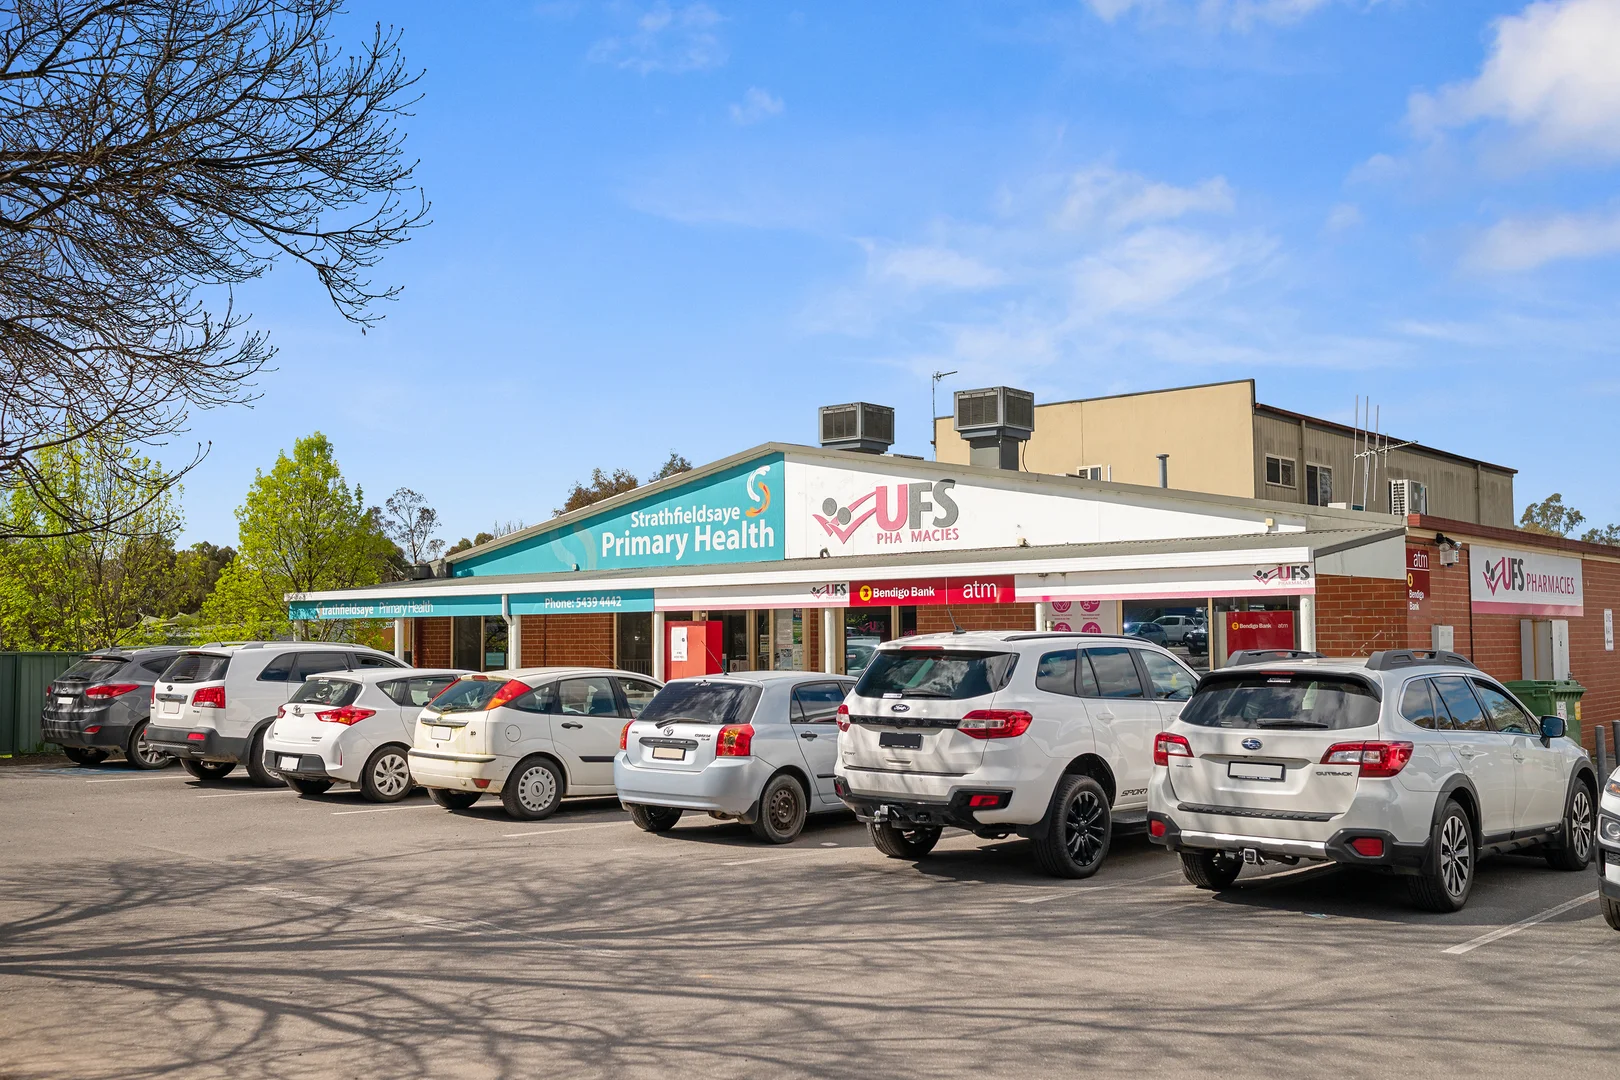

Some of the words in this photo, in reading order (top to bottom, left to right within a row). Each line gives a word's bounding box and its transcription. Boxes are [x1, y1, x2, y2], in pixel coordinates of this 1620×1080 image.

[876, 478, 959, 531] UFS
[631, 504, 740, 528] Strathfieldsaye
[602, 530, 689, 560] Primary
[694, 519, 775, 552] Health
[1413, 551, 1428, 568] atm
[1278, 565, 1310, 581] UFS
[1502, 557, 1525, 592] UFS
[1526, 573, 1575, 595] PHARMACIES
[826, 583, 846, 596] UFS
[873, 587, 910, 600] Bendigo
[911, 586, 936, 597] Bank
[963, 580, 997, 599] atm
[1409, 590, 1424, 600] Bendigo
[379, 602, 406, 617] Primary
[407, 600, 434, 614] Health
[545, 597, 575, 609] Phone:
[576, 596, 598, 608] 5439
[599, 595, 622, 607] 4442
[1410, 601, 1420, 611] Bank
[1120, 788, 1148, 797] SPORT
